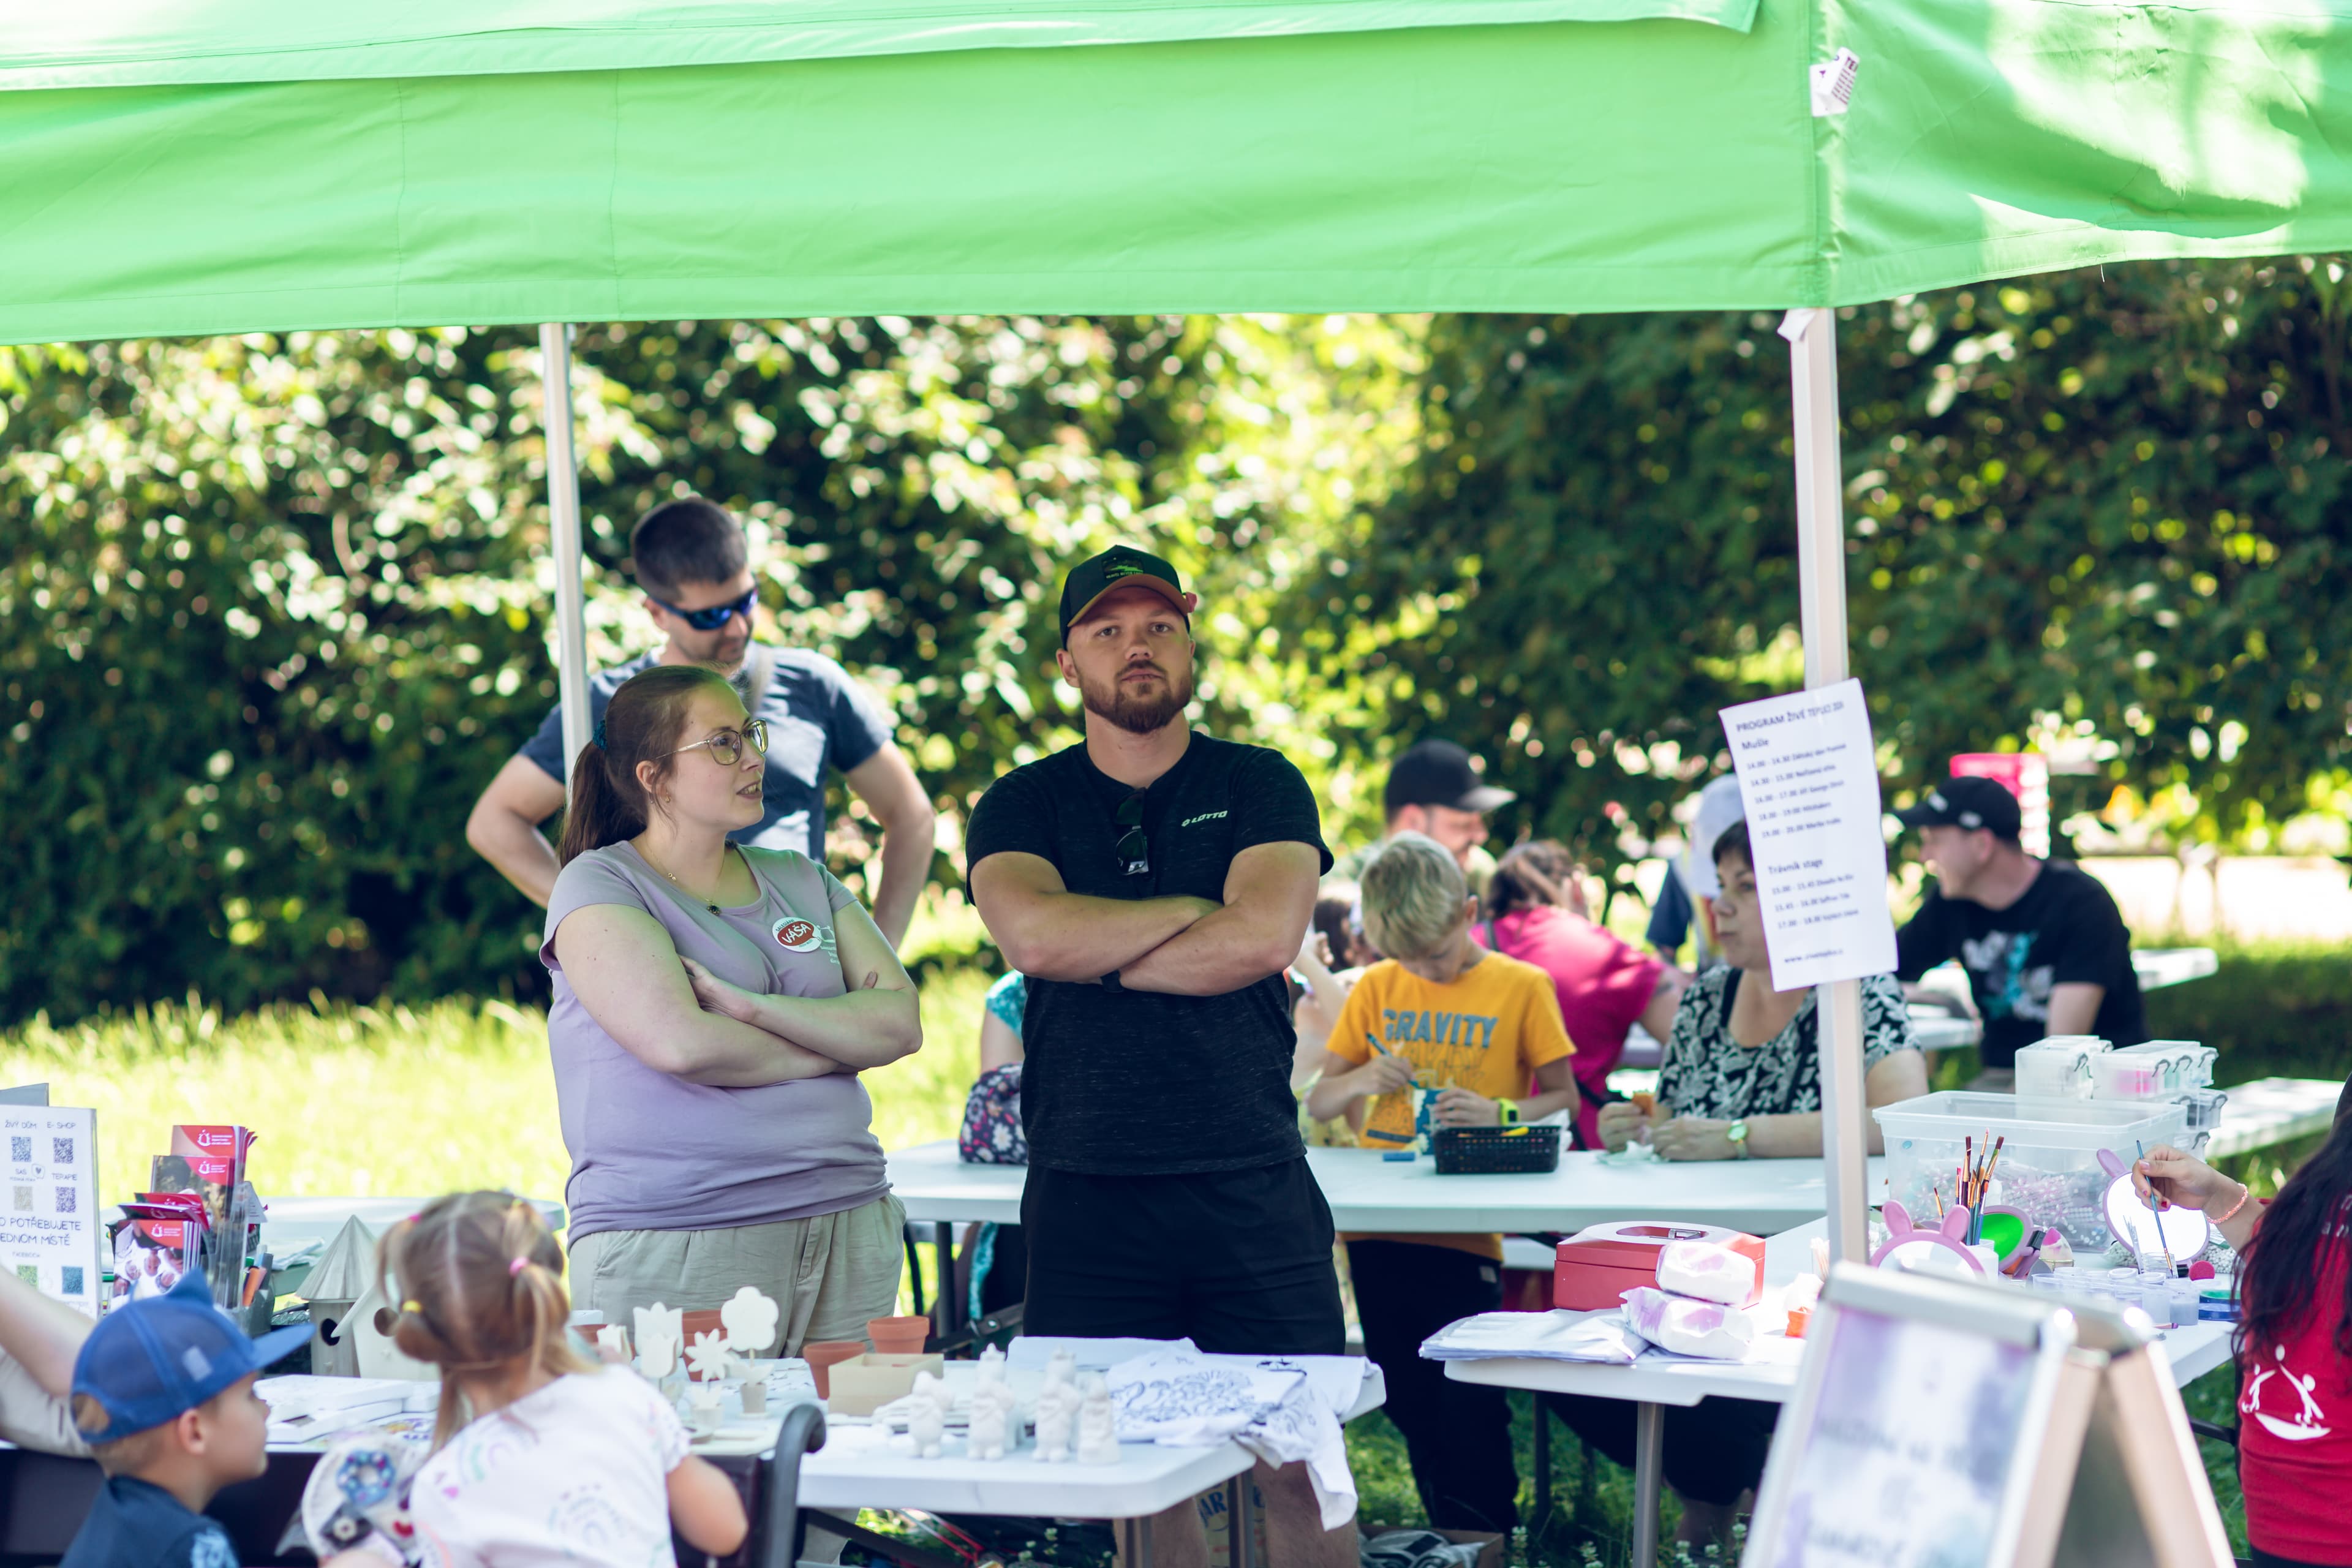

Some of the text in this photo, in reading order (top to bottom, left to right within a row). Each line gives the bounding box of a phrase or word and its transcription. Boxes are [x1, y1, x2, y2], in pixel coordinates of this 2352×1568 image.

[1736, 715, 1785, 732] PROGRAM
[1191, 810, 1227, 823] LOTTO
[1803, 859, 1822, 868] stage
[782, 924, 812, 943] VÁŠA
[1383, 1009, 1498, 1049] GRAVITY
[5, 1120, 19, 1128] ŽIVÝ
[10, 1216, 81, 1231] POTŘEBUJETE
[40, 1234, 71, 1246] MÍSTĚ
